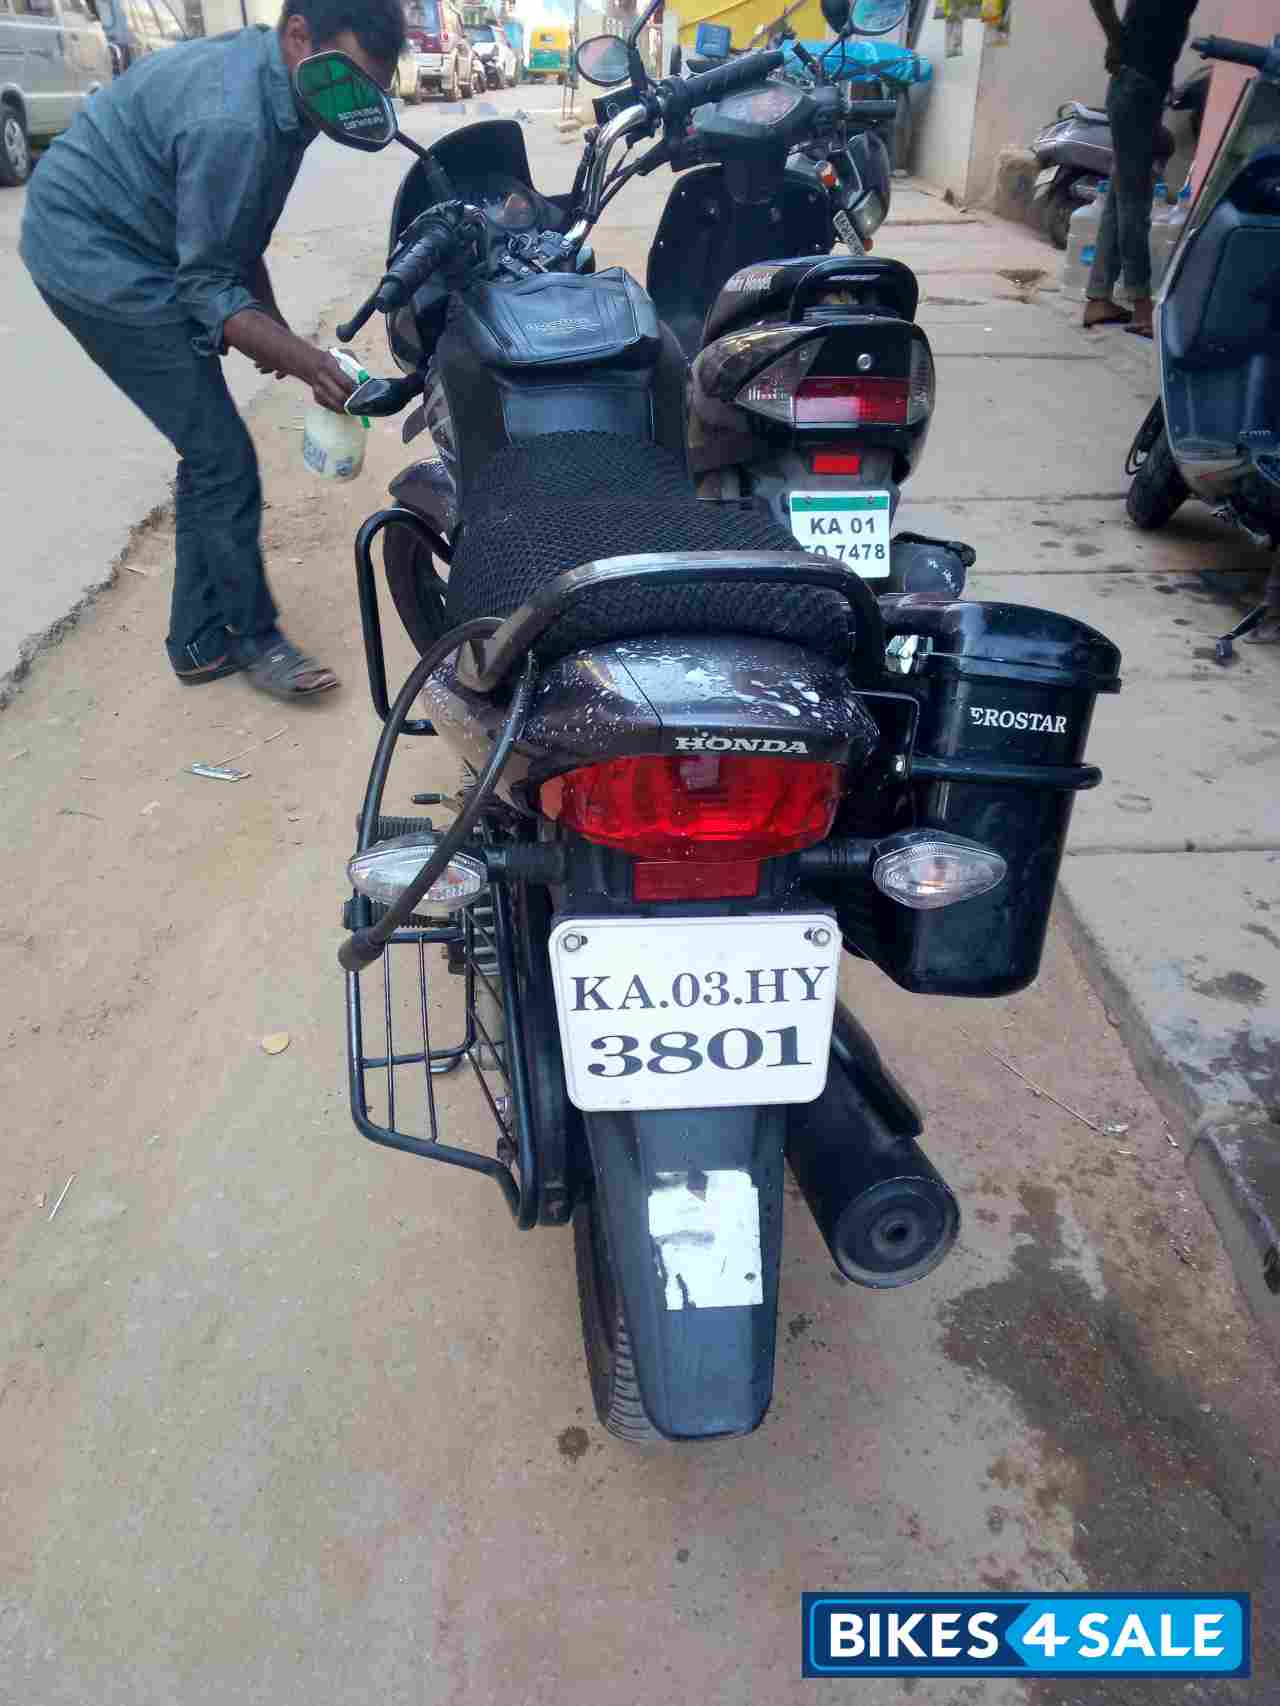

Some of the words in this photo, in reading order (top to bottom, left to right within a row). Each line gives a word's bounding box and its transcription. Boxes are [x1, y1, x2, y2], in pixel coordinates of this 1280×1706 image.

[810, 517, 842, 535] KA
[850, 517, 875, 534] 01
[835, 543, 886, 560] 7478
[675, 736, 808, 753] HONDA
[570, 966, 830, 1011] KA.03.HY
[587, 1025, 813, 1077] 3801
